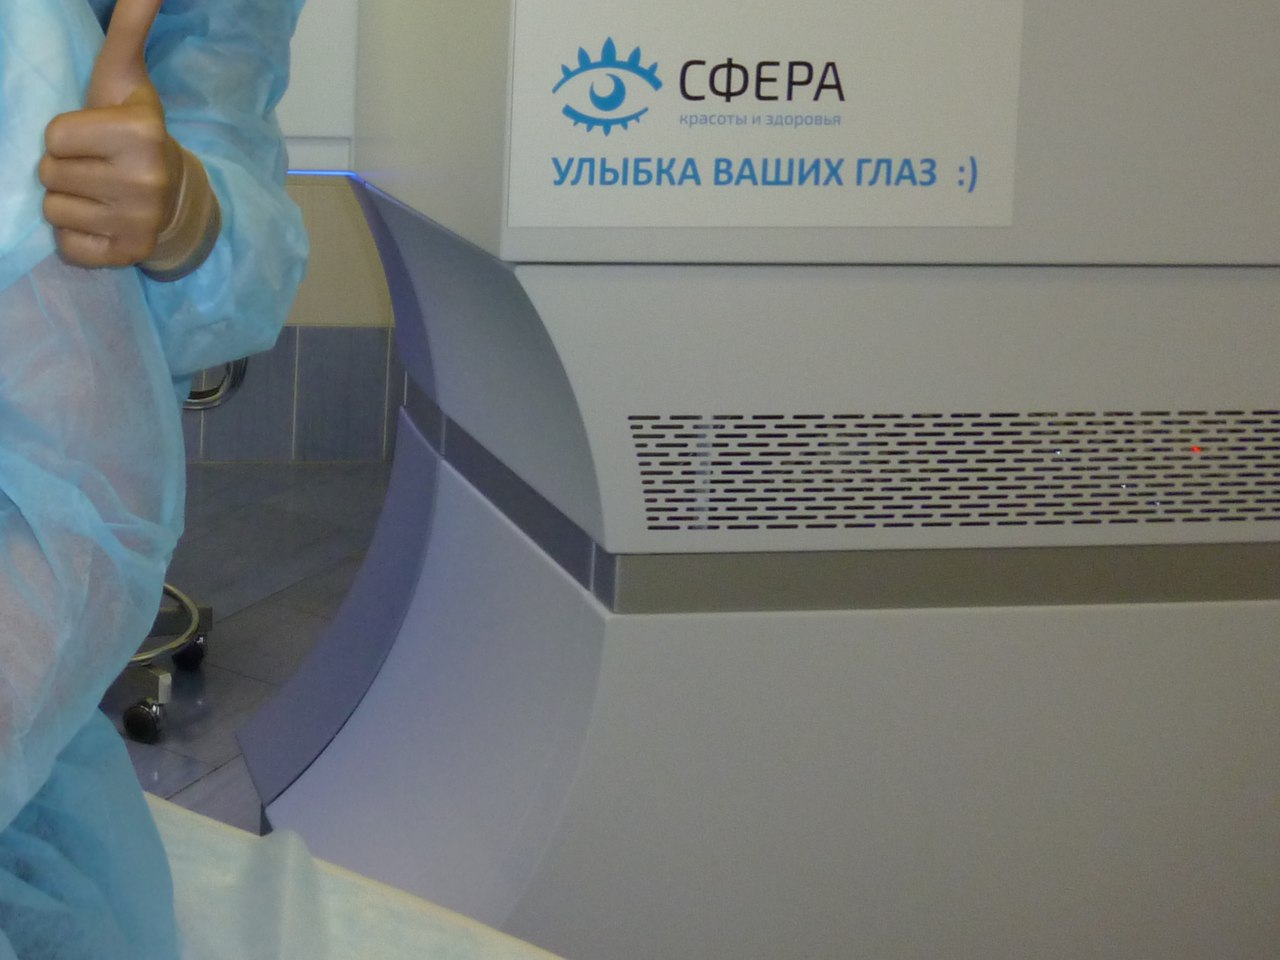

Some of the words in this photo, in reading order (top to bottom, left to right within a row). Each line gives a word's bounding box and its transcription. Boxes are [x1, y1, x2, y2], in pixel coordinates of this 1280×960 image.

[679, 57, 846, 103] СФЕРА
[679, 113, 748, 127] красоты
[751, 115, 761, 125] и
[766, 113, 842, 128] здоровья
[551, 157, 702, 186] УЛЫБКА
[713, 157, 844, 187] ВАШИХ
[856, 158, 937, 187] ГЛАЗ
